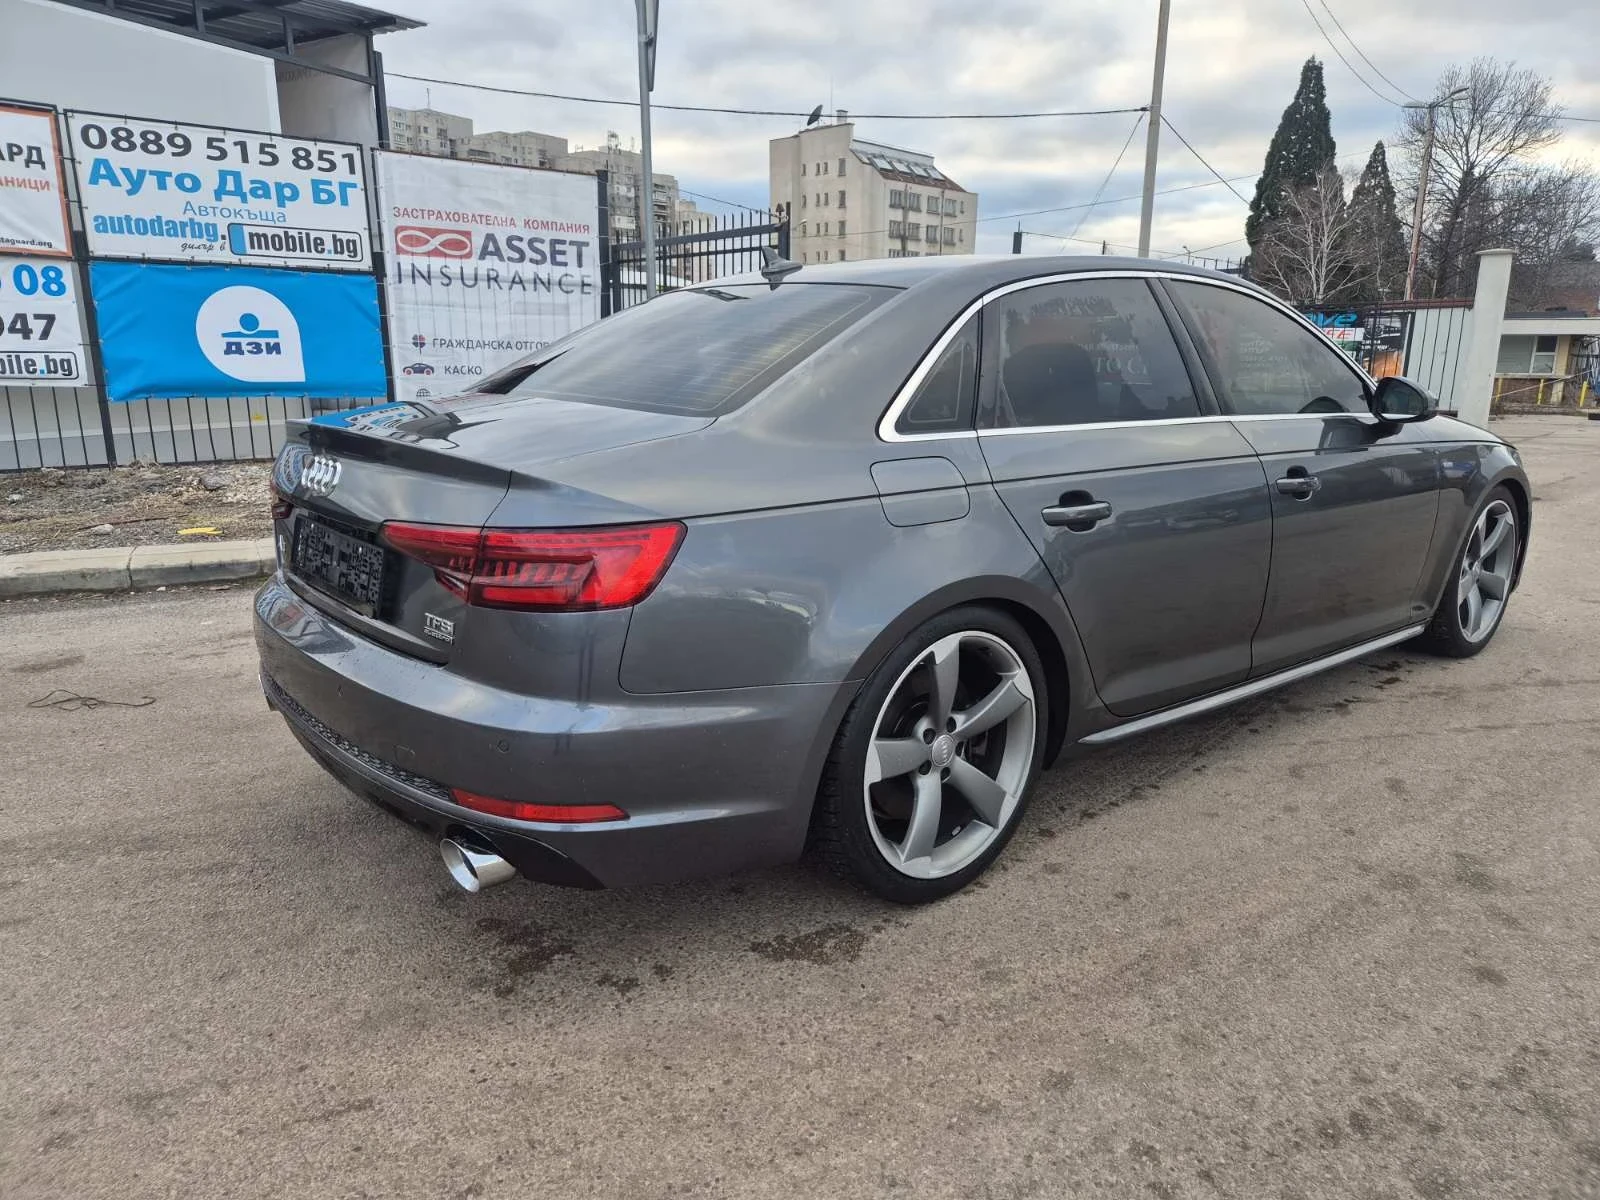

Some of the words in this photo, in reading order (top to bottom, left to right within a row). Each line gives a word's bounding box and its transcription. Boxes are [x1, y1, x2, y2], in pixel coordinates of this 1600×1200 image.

[81, 123, 192, 158] 0889
[206, 136, 280, 167] 515
[291, 146, 356, 175] 851
[88, 157, 202, 196] Ауто
[213, 169, 300, 208] Дар
[310, 178, 358, 206] БГ
[183, 200, 287, 225] Автокъща
[393, 206, 517, 229] ЗАСТРАХОВАТЕЛНА
[523, 218, 590, 234] КОМПАНИЯ
[248, 230, 359, 259] mobile.bg
[478, 233, 590, 268] ASSET
[13, 263, 67, 297] 08
[396, 261, 593, 295] INSURANCE
[0, 312, 56, 341] 47
[223, 341, 282, 355] ДЗИ
[432, 338, 513, 351] ГРАЖДАНСКА
[444, 365, 482, 376] КАСКО
[424, 612, 454, 637] TFSI
